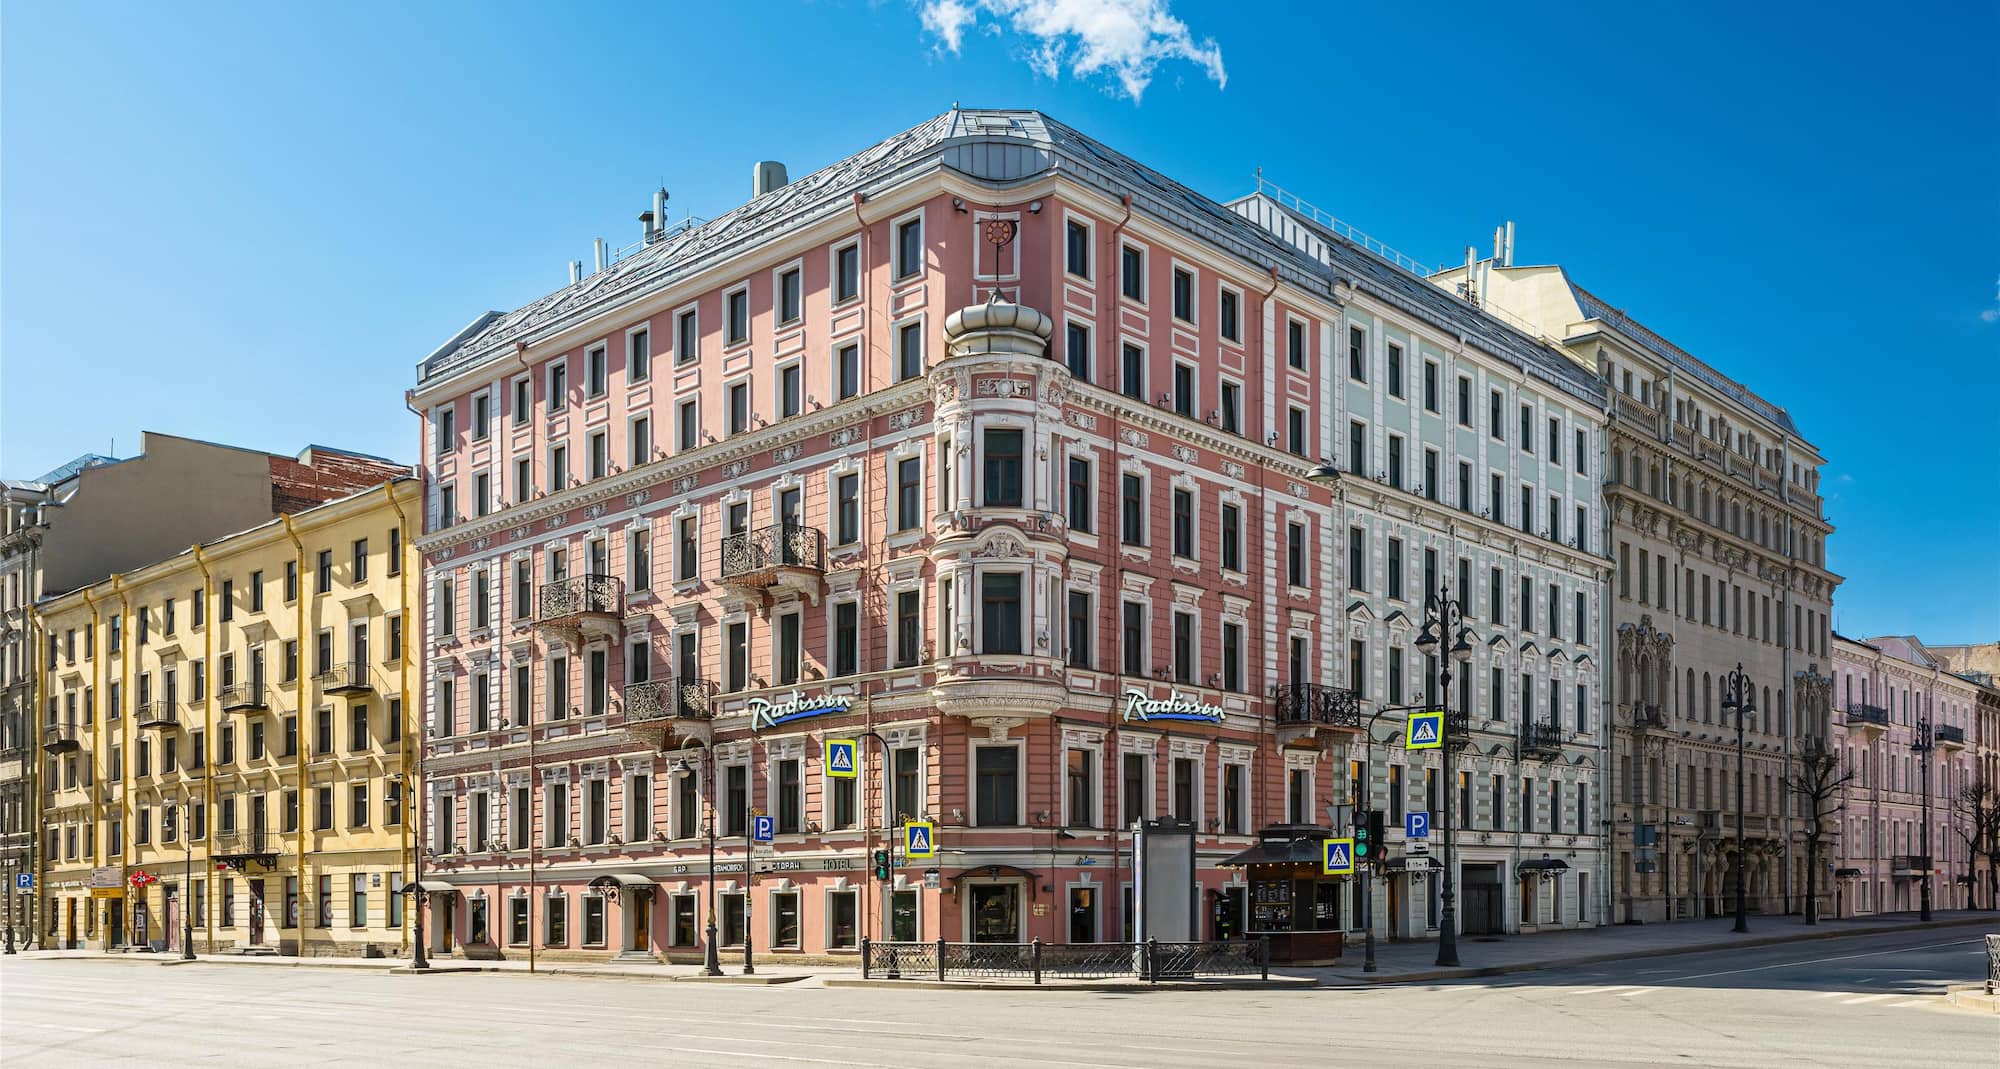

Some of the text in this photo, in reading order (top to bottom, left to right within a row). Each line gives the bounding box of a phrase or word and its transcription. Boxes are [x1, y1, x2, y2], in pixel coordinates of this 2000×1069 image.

[748, 688, 851, 732] Radisson
[1123, 688, 1226, 722] Radisson
[759, 818, 770, 838] P
[1412, 815, 1425, 836] P
[772, 862, 800, 870] СТОРАН
[823, 859, 849, 871] HOTEL
[21, 875, 30, 886] P
